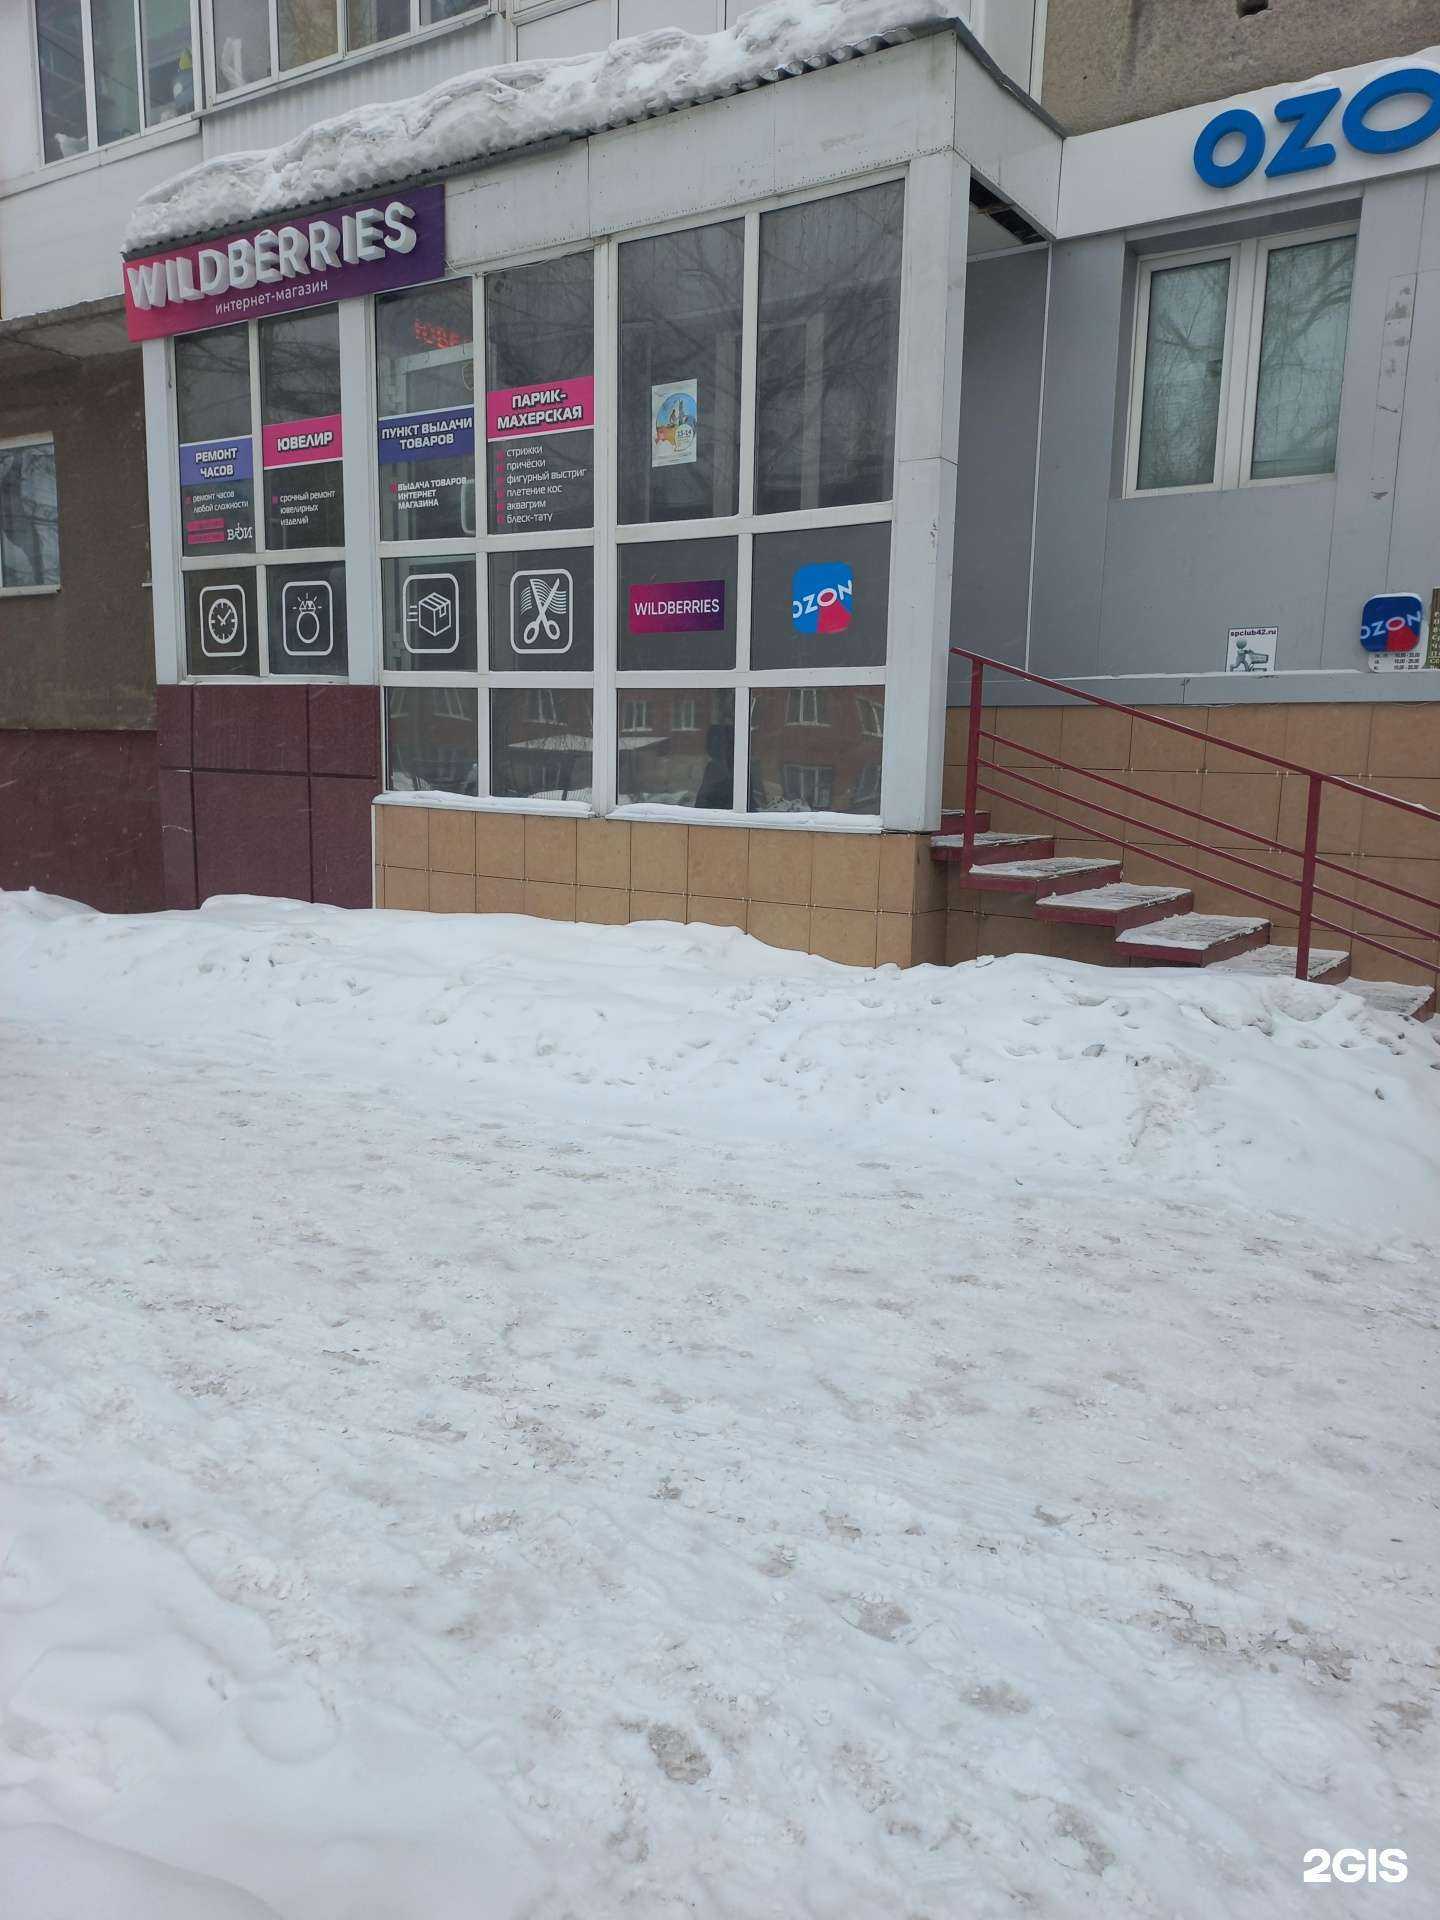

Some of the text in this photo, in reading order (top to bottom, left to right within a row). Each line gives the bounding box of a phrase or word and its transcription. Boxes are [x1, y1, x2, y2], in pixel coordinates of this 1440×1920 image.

[126, 201, 417, 310] WILDBERRIES
[215, 279, 328, 316] интернет-магазин
[511, 389, 566, 409] ПАРИК-
[497, 405, 582, 430] МАХЕРСКАЯ
[381, 417, 472, 439] ПУНКТ ВЫДАЧИ
[277, 431, 333, 452] ЮВЕЛИР
[400, 433, 454, 450] ТОВАРОВ
[195, 447, 238, 463] РЕМОНТ
[506, 445, 543, 458] стрижки
[200, 464, 234, 478] ЧАСОВ
[506, 468, 587, 486] фигурный выстриг
[398, 477, 467, 491] ВЫДАЧА ТОВАРОВ
[506, 484, 563, 498] плетение кос
[398, 489, 437, 500] ИНТЕРНЕТ
[398, 498, 439, 510] МАГАЗИНА
[506, 499, 547, 512] аквагрим
[506, 512, 553, 525] блеск-тату
[634, 599, 720, 616] WILDBERRIES
[792, 579, 853, 619] OZON
[1359, 610, 1422, 639] OZON
